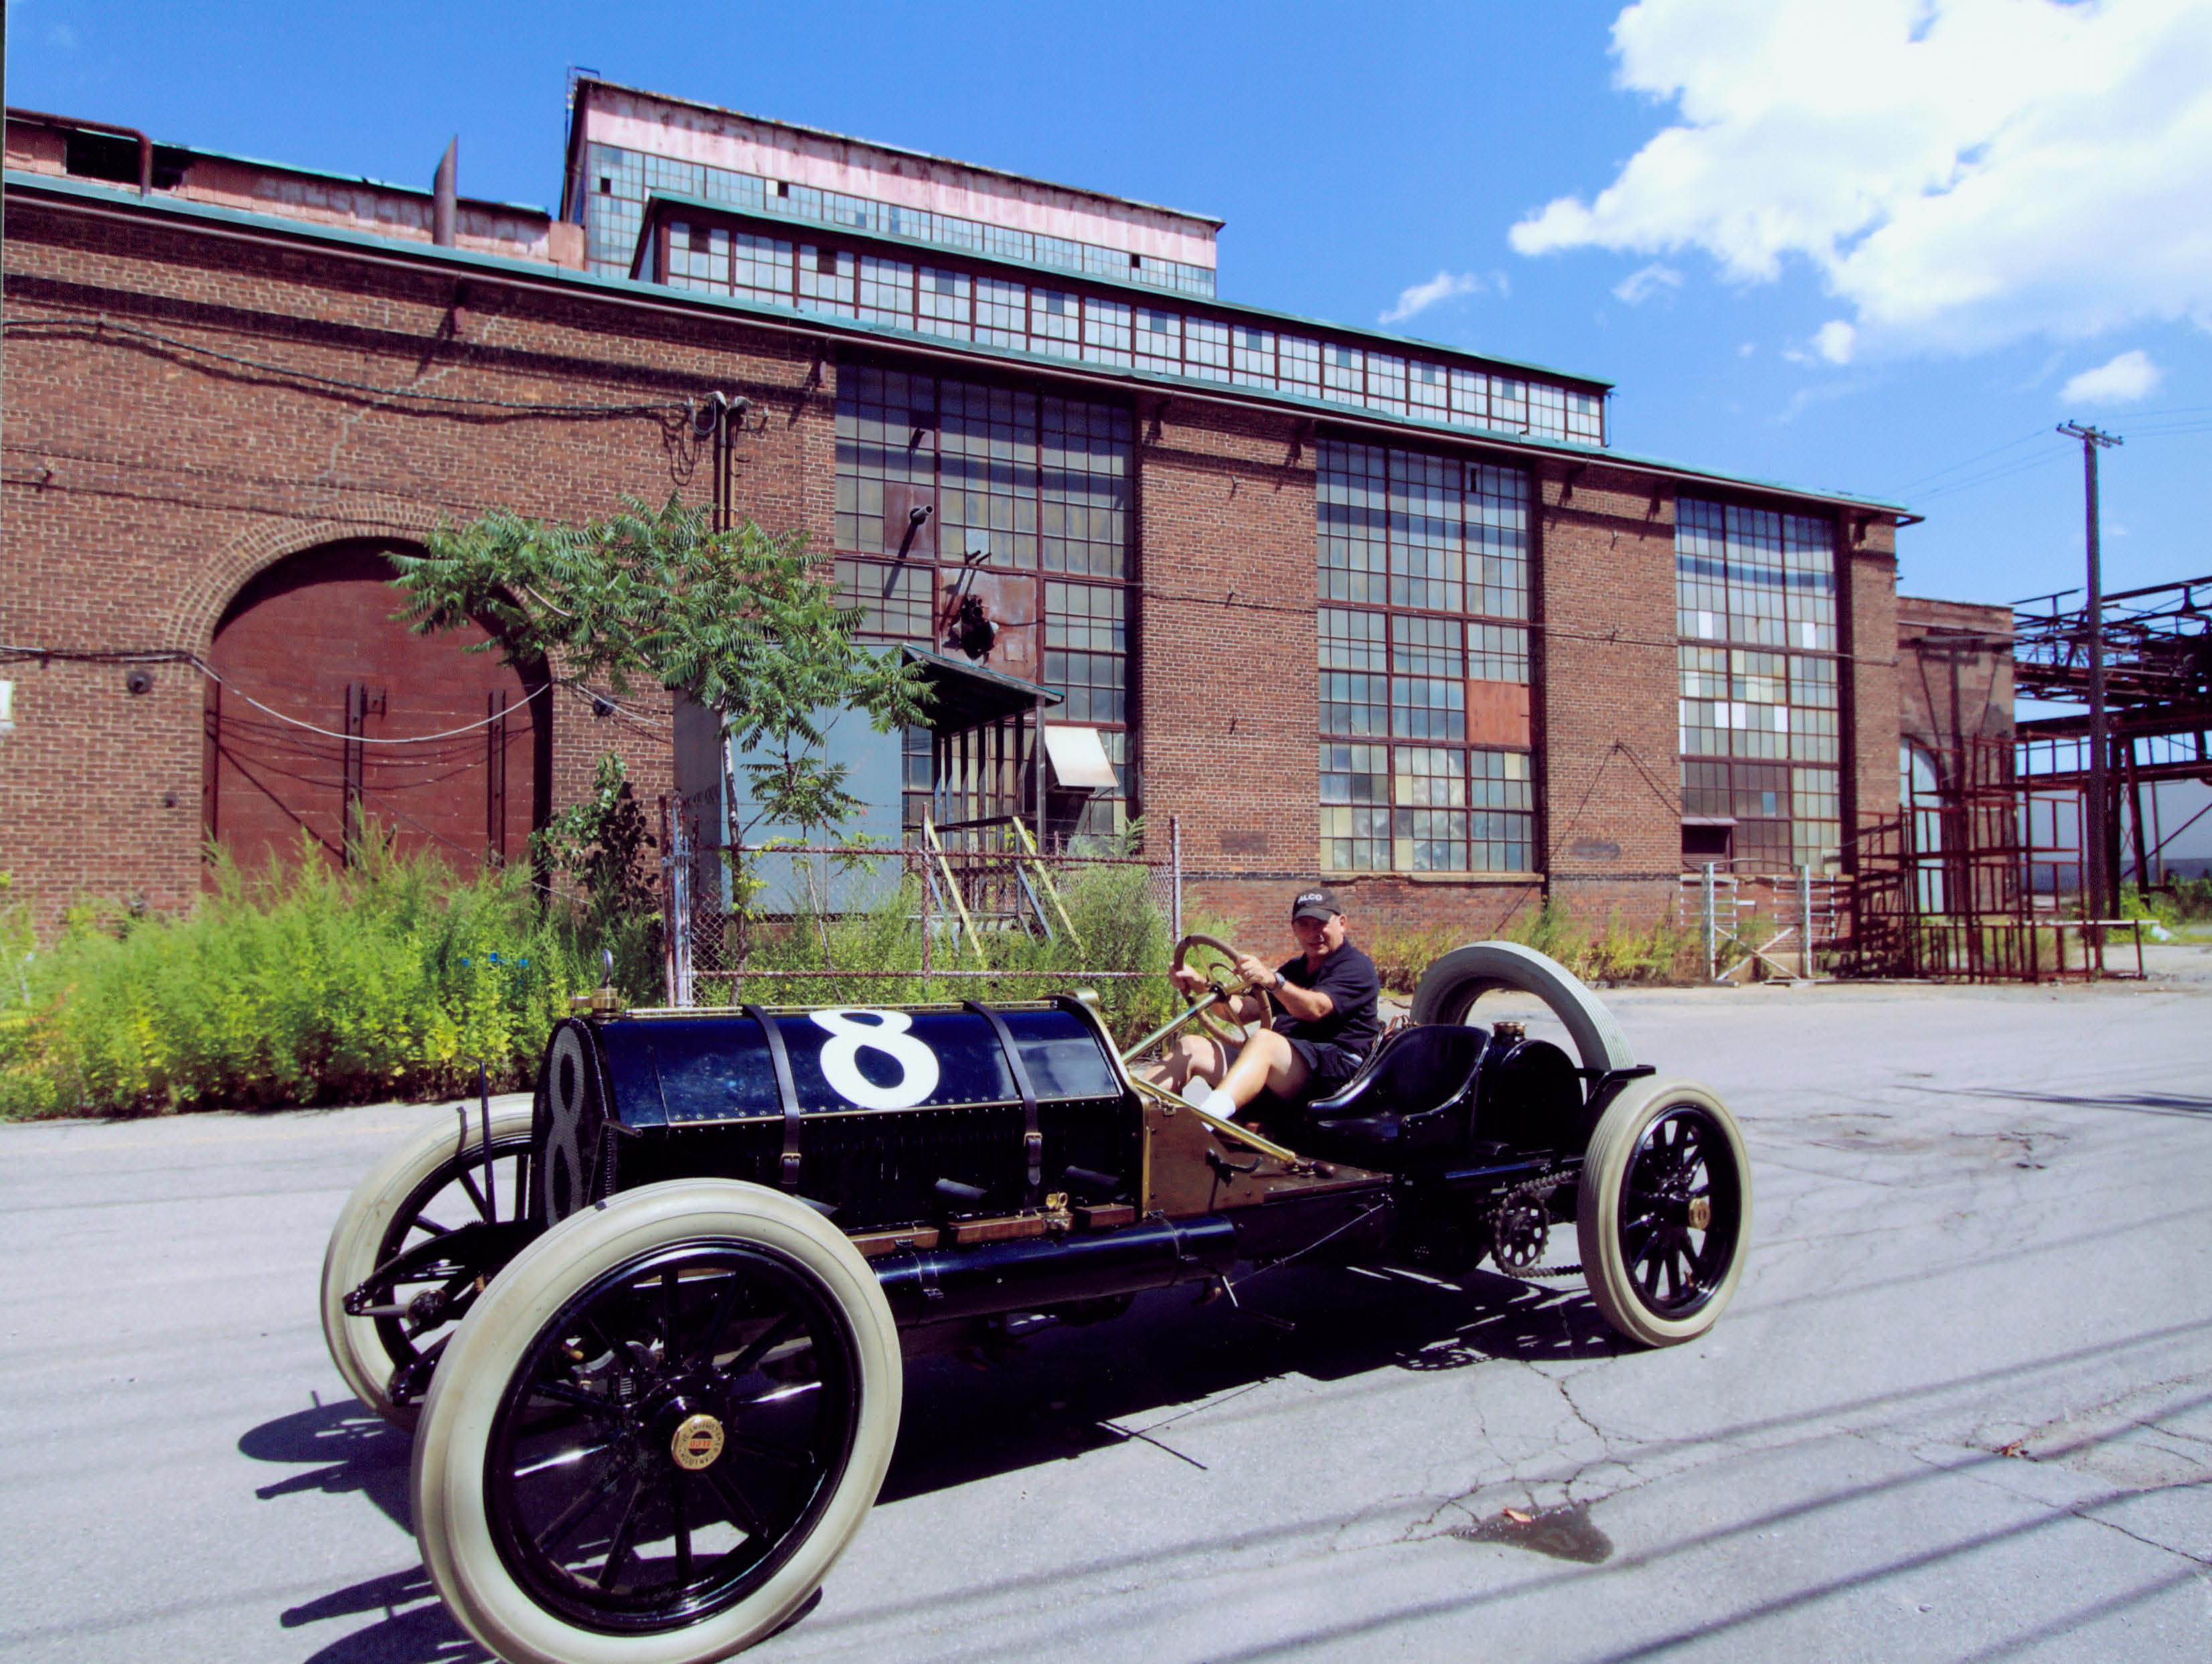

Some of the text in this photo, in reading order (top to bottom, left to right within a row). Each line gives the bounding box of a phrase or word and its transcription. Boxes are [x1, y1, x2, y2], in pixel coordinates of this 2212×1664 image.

[1297, 893, 1322, 903] ALCO
[809, 1008, 939, 1110] 8
[544, 1025, 584, 1228] 8
